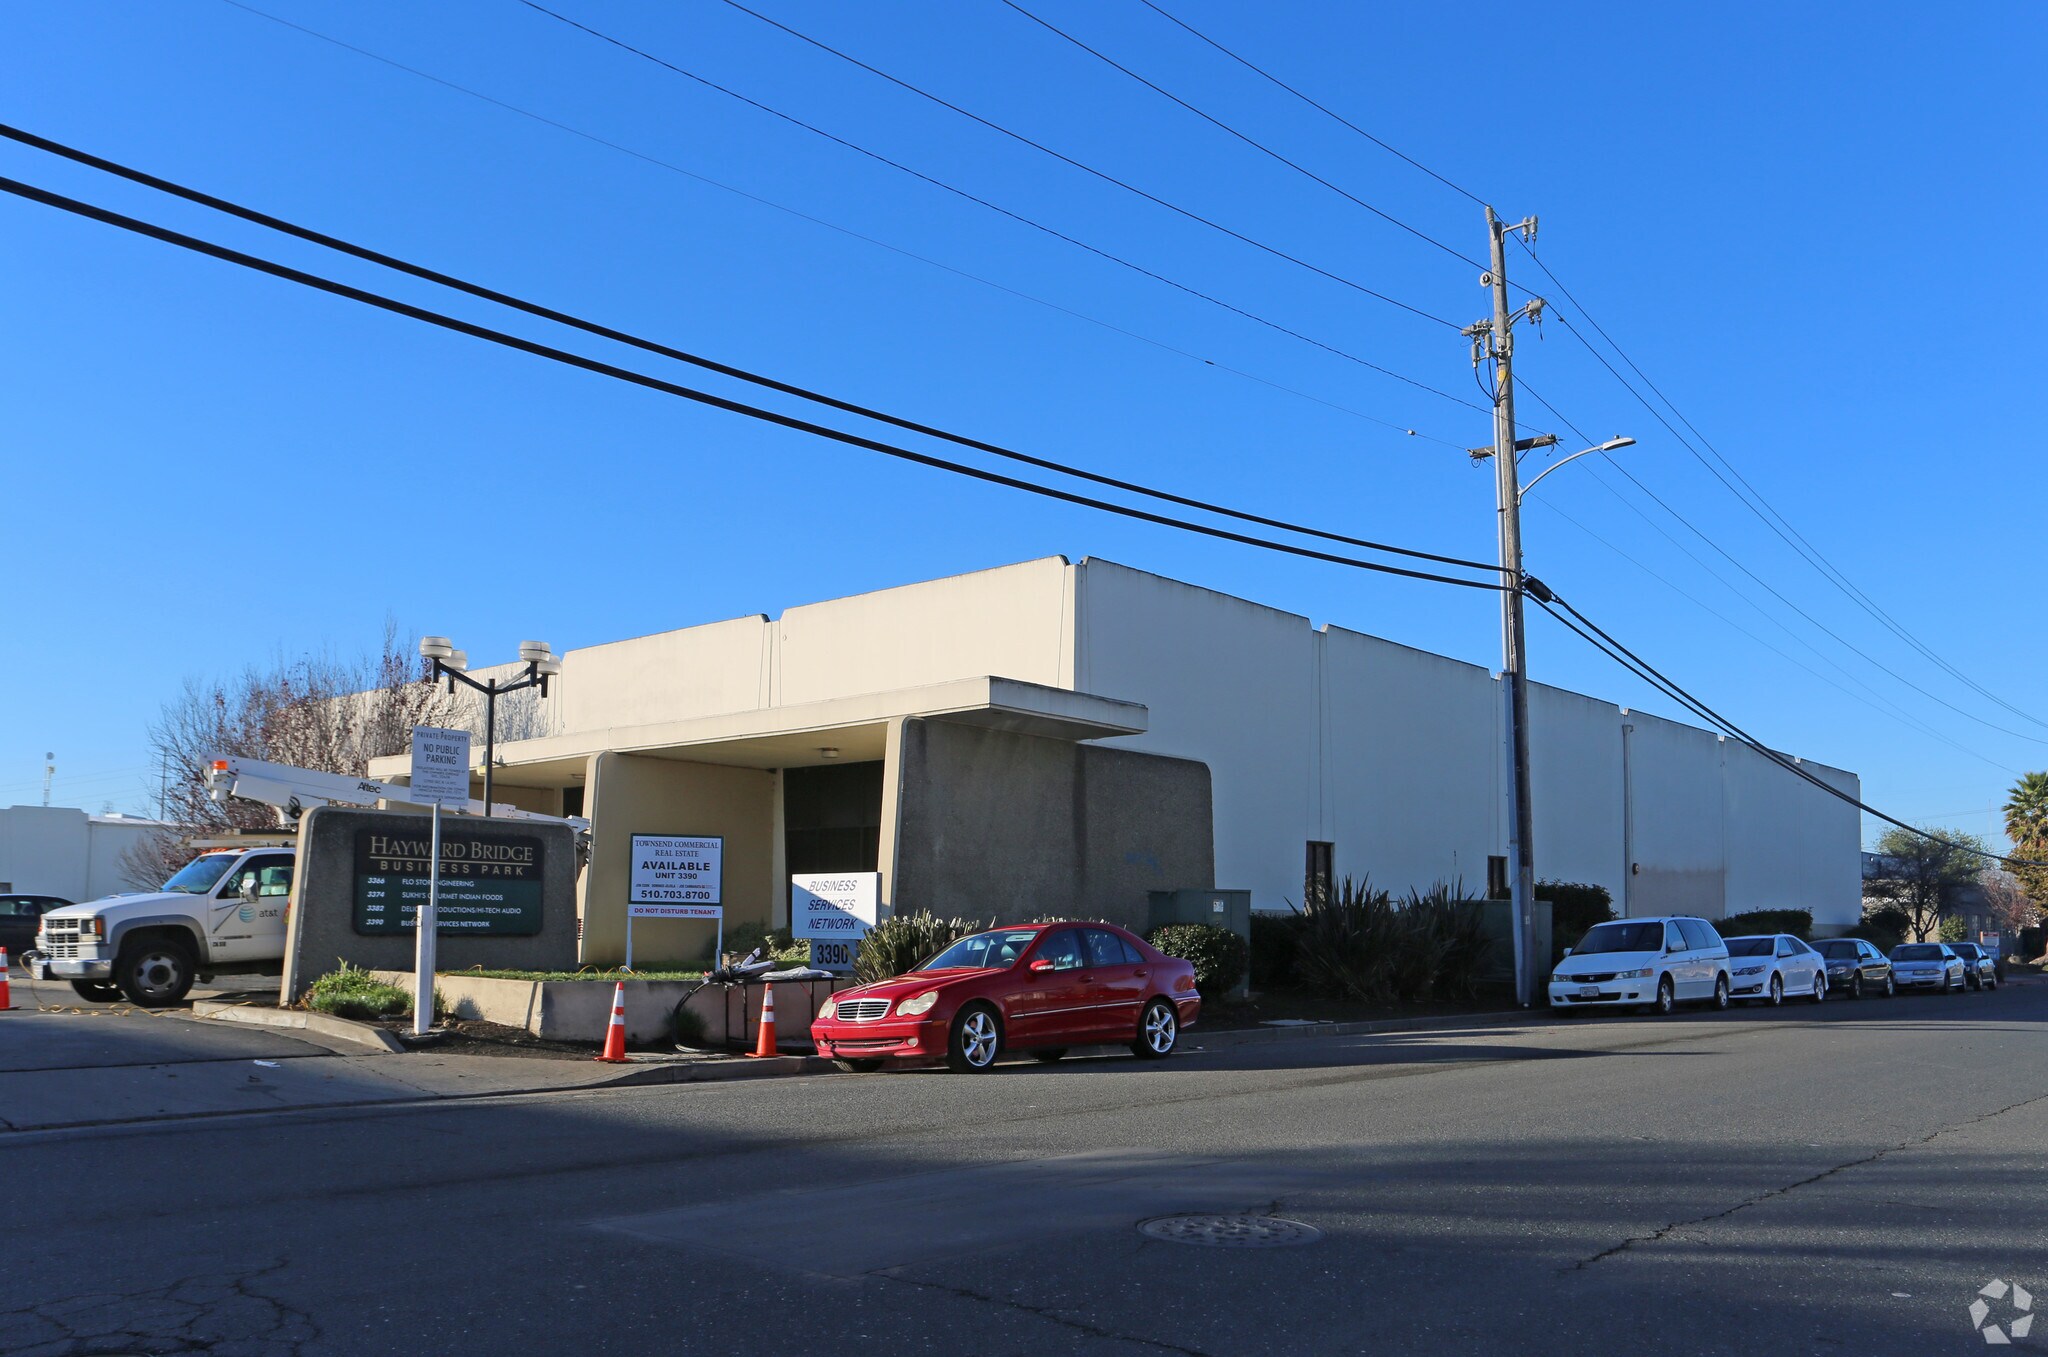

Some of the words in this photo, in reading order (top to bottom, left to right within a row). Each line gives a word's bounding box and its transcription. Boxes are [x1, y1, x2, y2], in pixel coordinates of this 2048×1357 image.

[416, 731, 439, 740] PRIVATE
[441, 733, 468, 742] PROPERTY
[424, 744, 434, 752] NO
[436, 745, 460, 755] PUBLIC
[426, 754, 456, 765] PARKING
[357, 782, 381, 794] Altec
[635, 840, 673, 848] TOWNSEND
[674, 841, 719, 849] COMMERCIAL
[470, 842, 534, 861] BRIDGE
[481, 864, 524, 876] PARK
[641, 861, 710, 871] AVAILABLE
[809, 880, 858, 892] BUSINESS
[641, 890, 710, 900] 510.703.8700
[808, 899, 856, 911] SERVICES
[259, 909, 278, 918] at&t
[808, 918, 858, 929] NETWORK
[817, 944, 848, 964] 3390
